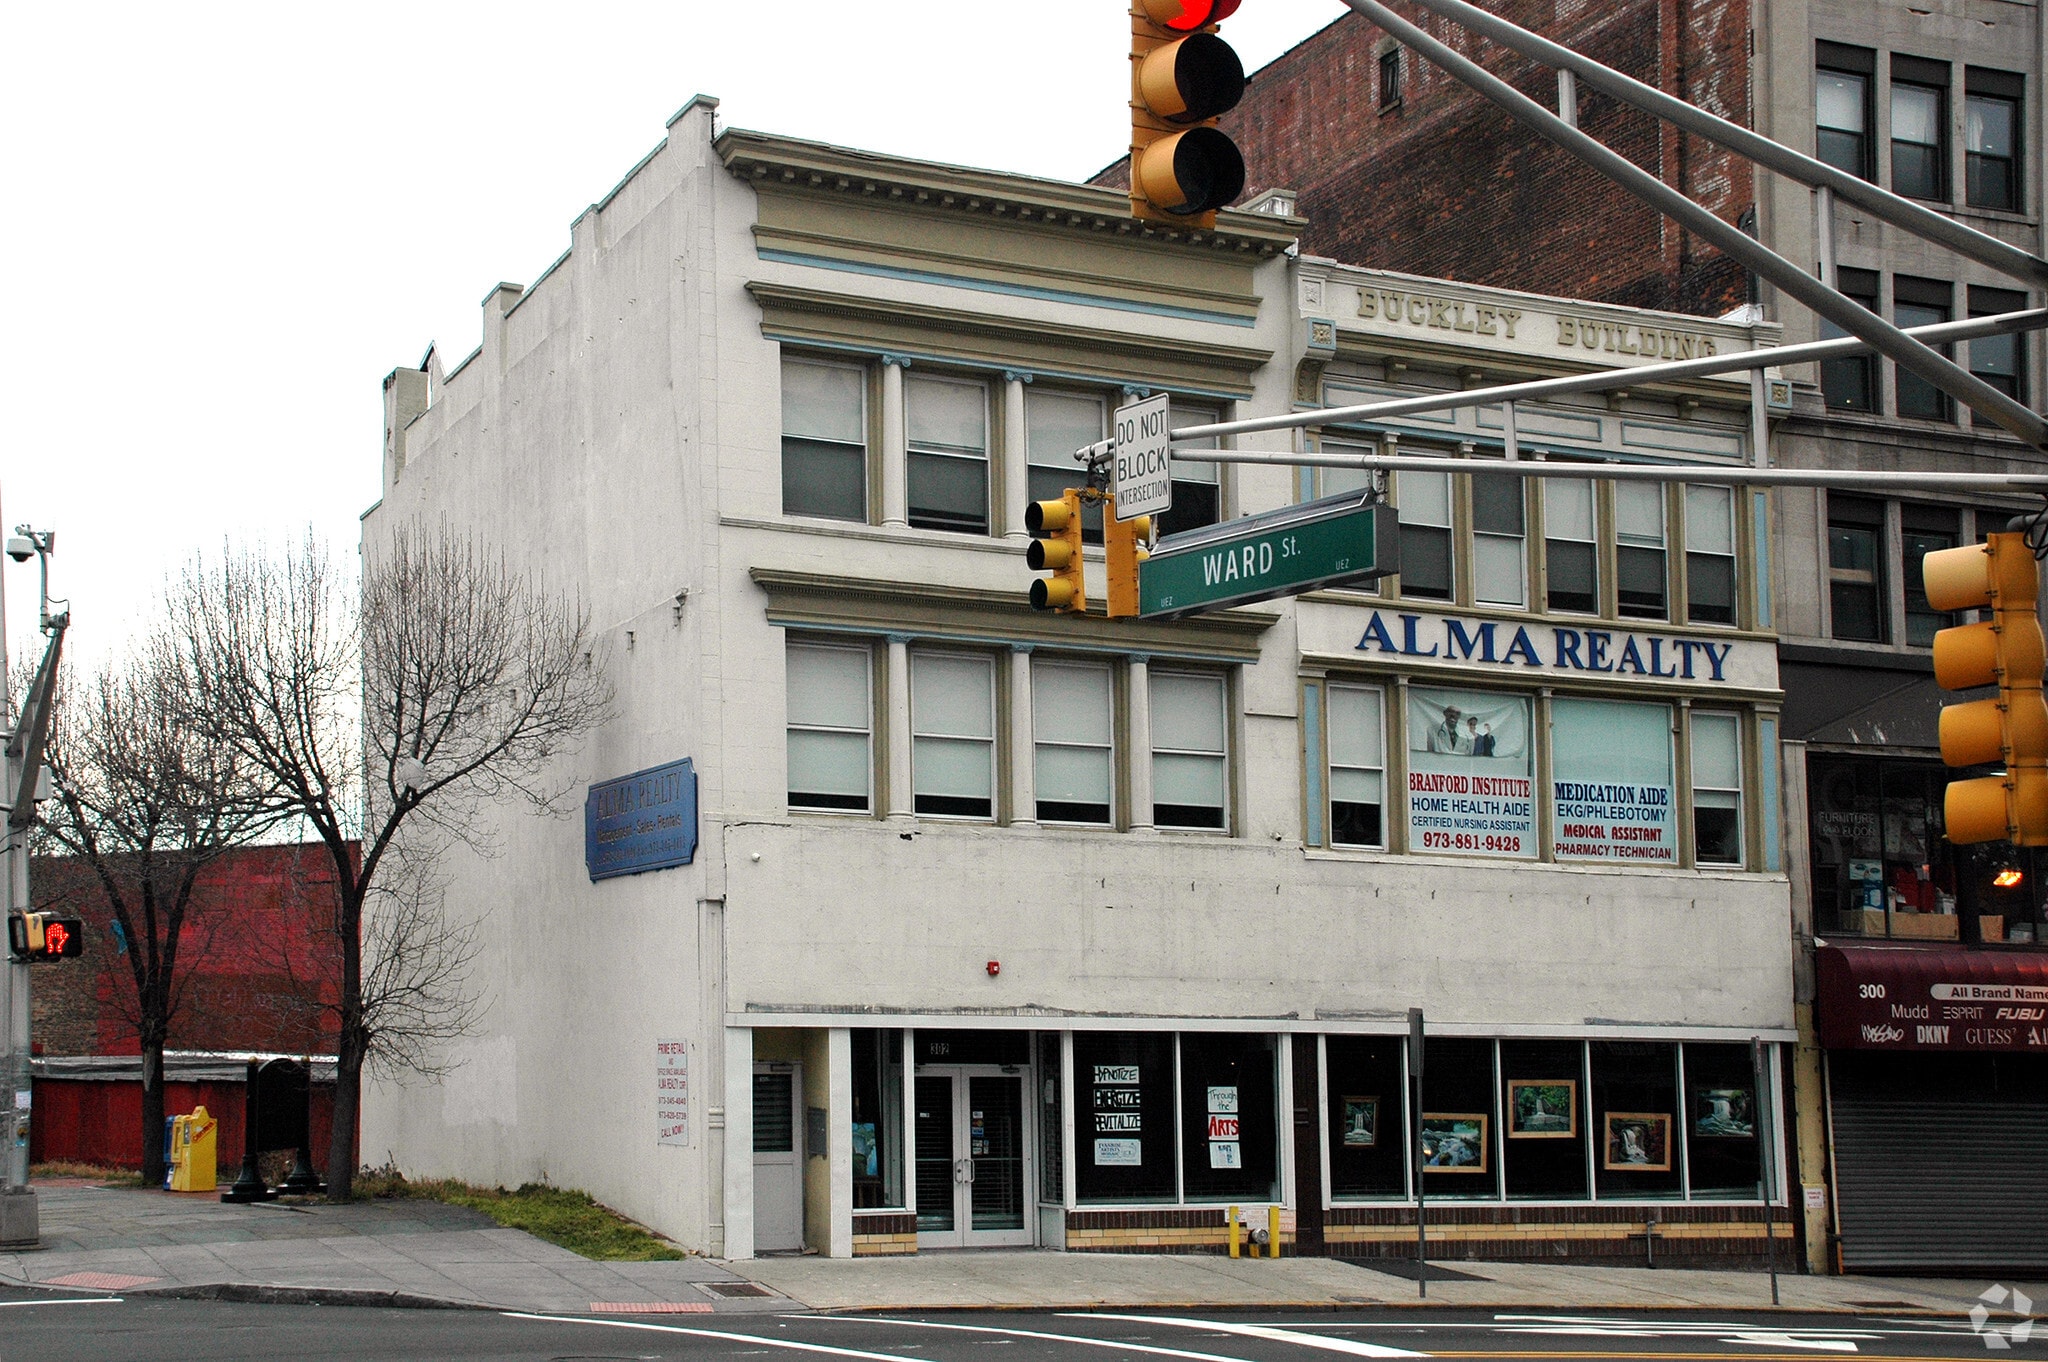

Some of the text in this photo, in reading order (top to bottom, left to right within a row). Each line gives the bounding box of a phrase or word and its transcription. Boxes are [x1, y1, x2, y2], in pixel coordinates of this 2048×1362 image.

[1356, 287, 1716, 359] BUCKLEY BUILDING
[1117, 409, 1165, 447] DO NOT
[1118, 446, 1166, 482] BLOCK
[1118, 479, 1168, 508] INTERSECTION
[1203, 536, 1301, 586] WARD St.
[1335, 558, 1350, 571] UEZ
[1160, 596, 1173, 608] UEZ
[1355, 610, 1732, 681] ALMA REALTY
[1409, 773, 1530, 798] BRANFORD INSTITUTE
[1555, 782, 1668, 806] MEDICATION AIDE
[1411, 797, 1530, 817] HOME HEALTH AIDE
[1557, 803, 1667, 822] EKG/PHLEBOTOMY
[1412, 816, 1530, 832] CERTIFIED NURSING ASSISTANT
[1819, 812, 1875, 824] FURNITURE
[1423, 832, 1521, 852] 973-881-9428
[1563, 824, 1662, 842] MEDICAL ASSISTANT
[1555, 843, 1671, 859] PHARMACY TECHNICIAN
[1859, 984, 1885, 999] 300
[1951, 986, 1968, 998] All
[1972, 986, 2011, 999] Brand
[1891, 1004, 2045, 1021] Mudd ESPRIT FUBU
[1917, 1025, 1950, 1044] DKNY
[930, 1042, 949, 1055] 302
[1094, 1067, 1138, 1083] HYPNOTIZE
[1095, 1090, 1140, 1107] ENERGIZE
[1208, 1089, 1237, 1103] Through
[1217, 1101, 1230, 1111] the
[1095, 1114, 1141, 1131] REVITALIZE
[1208, 1116, 1240, 1136] ARTS
